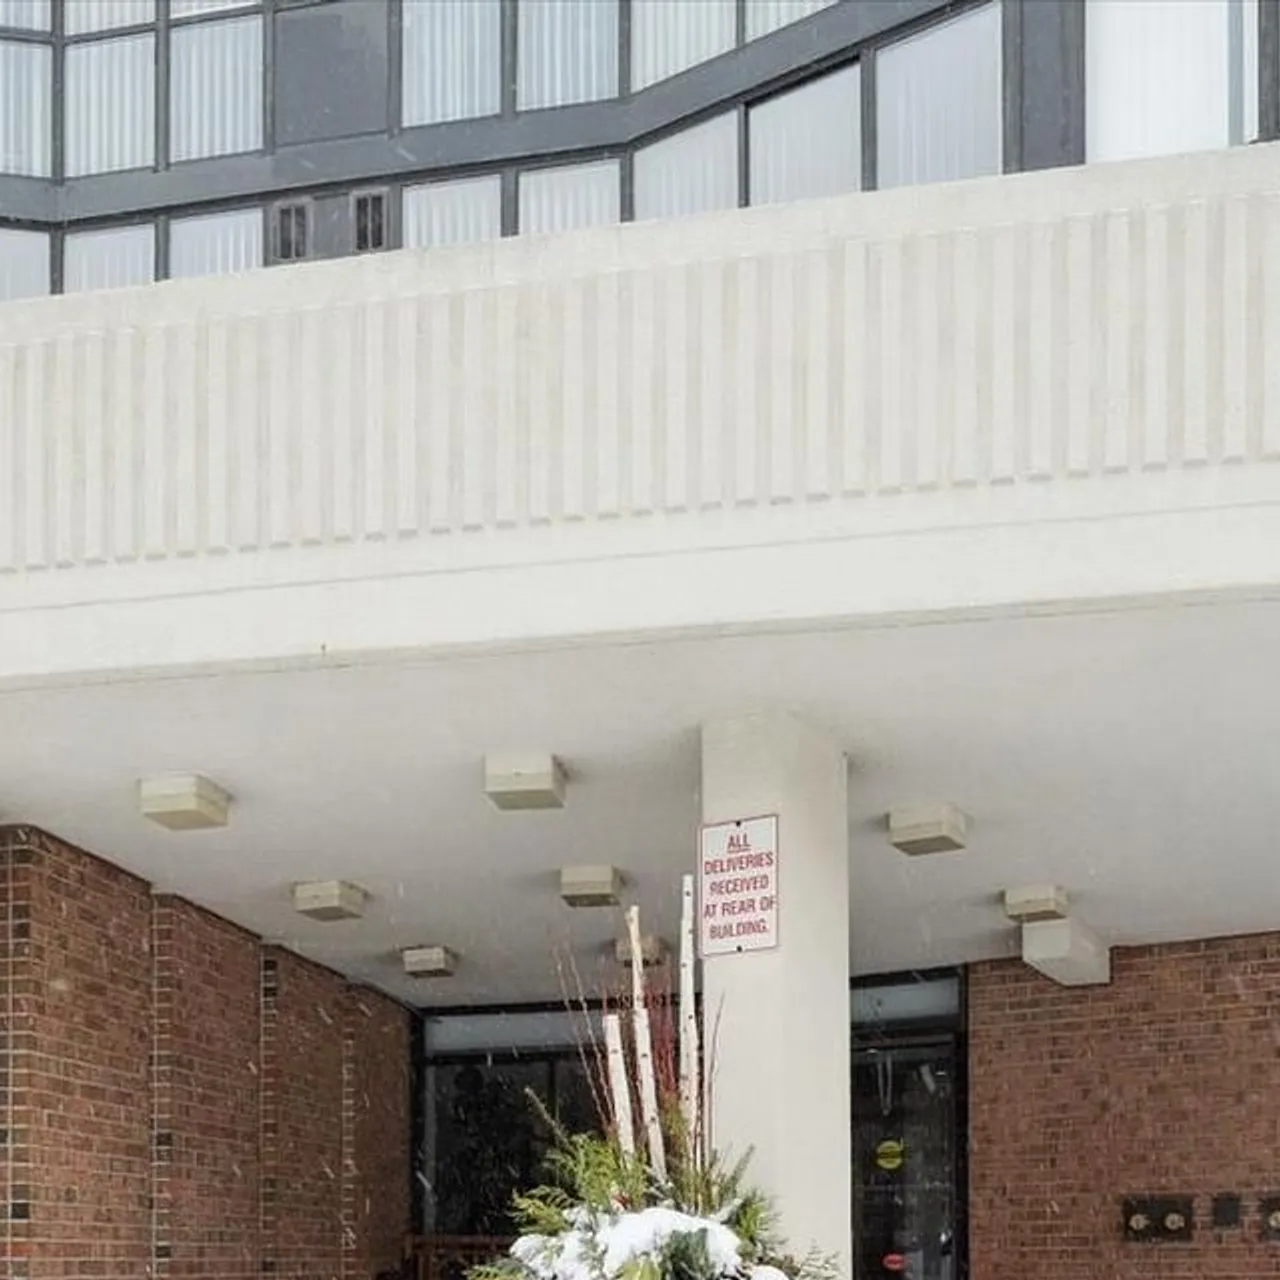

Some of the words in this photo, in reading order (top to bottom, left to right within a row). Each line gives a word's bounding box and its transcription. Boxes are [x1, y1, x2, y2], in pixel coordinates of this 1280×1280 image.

[727, 834, 751, 849] ALL
[704, 852, 773, 875] DELIVERIES
[710, 875, 769, 895] RECEIVED
[704, 903, 717, 919] AT
[722, 899, 755, 917] REAR
[760, 896, 775, 911] OF
